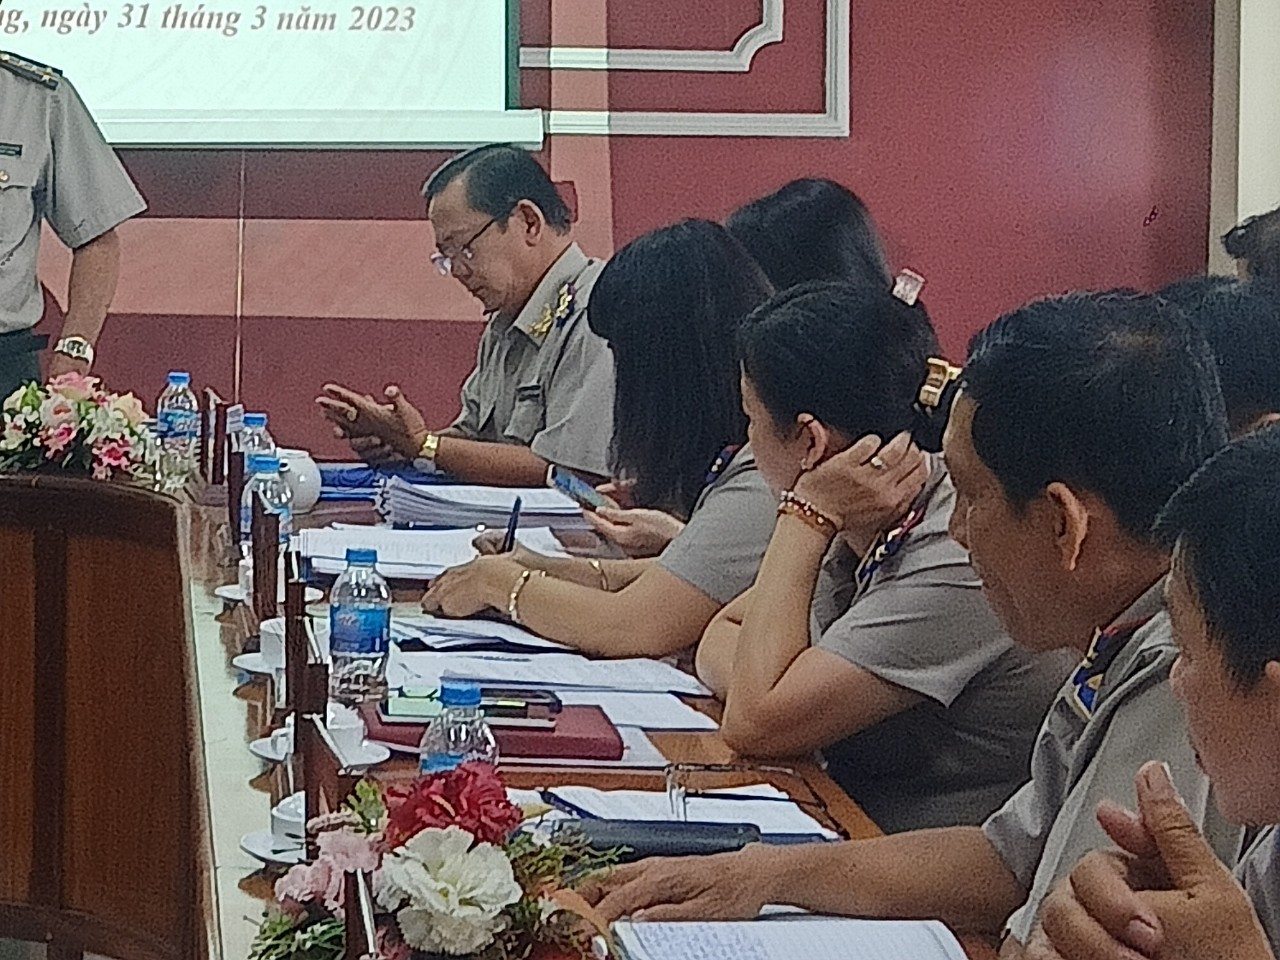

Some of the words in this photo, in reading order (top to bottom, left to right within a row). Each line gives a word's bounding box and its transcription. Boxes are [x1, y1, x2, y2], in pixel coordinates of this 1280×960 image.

[40, 2, 108, 35] ngày
[117, 3, 150, 29] 31
[160, 3, 241, 38] tháng
[250, 5, 267, 30] 3
[276, 6, 337, 31] năm
[348, 6, 417, 32] 2023
